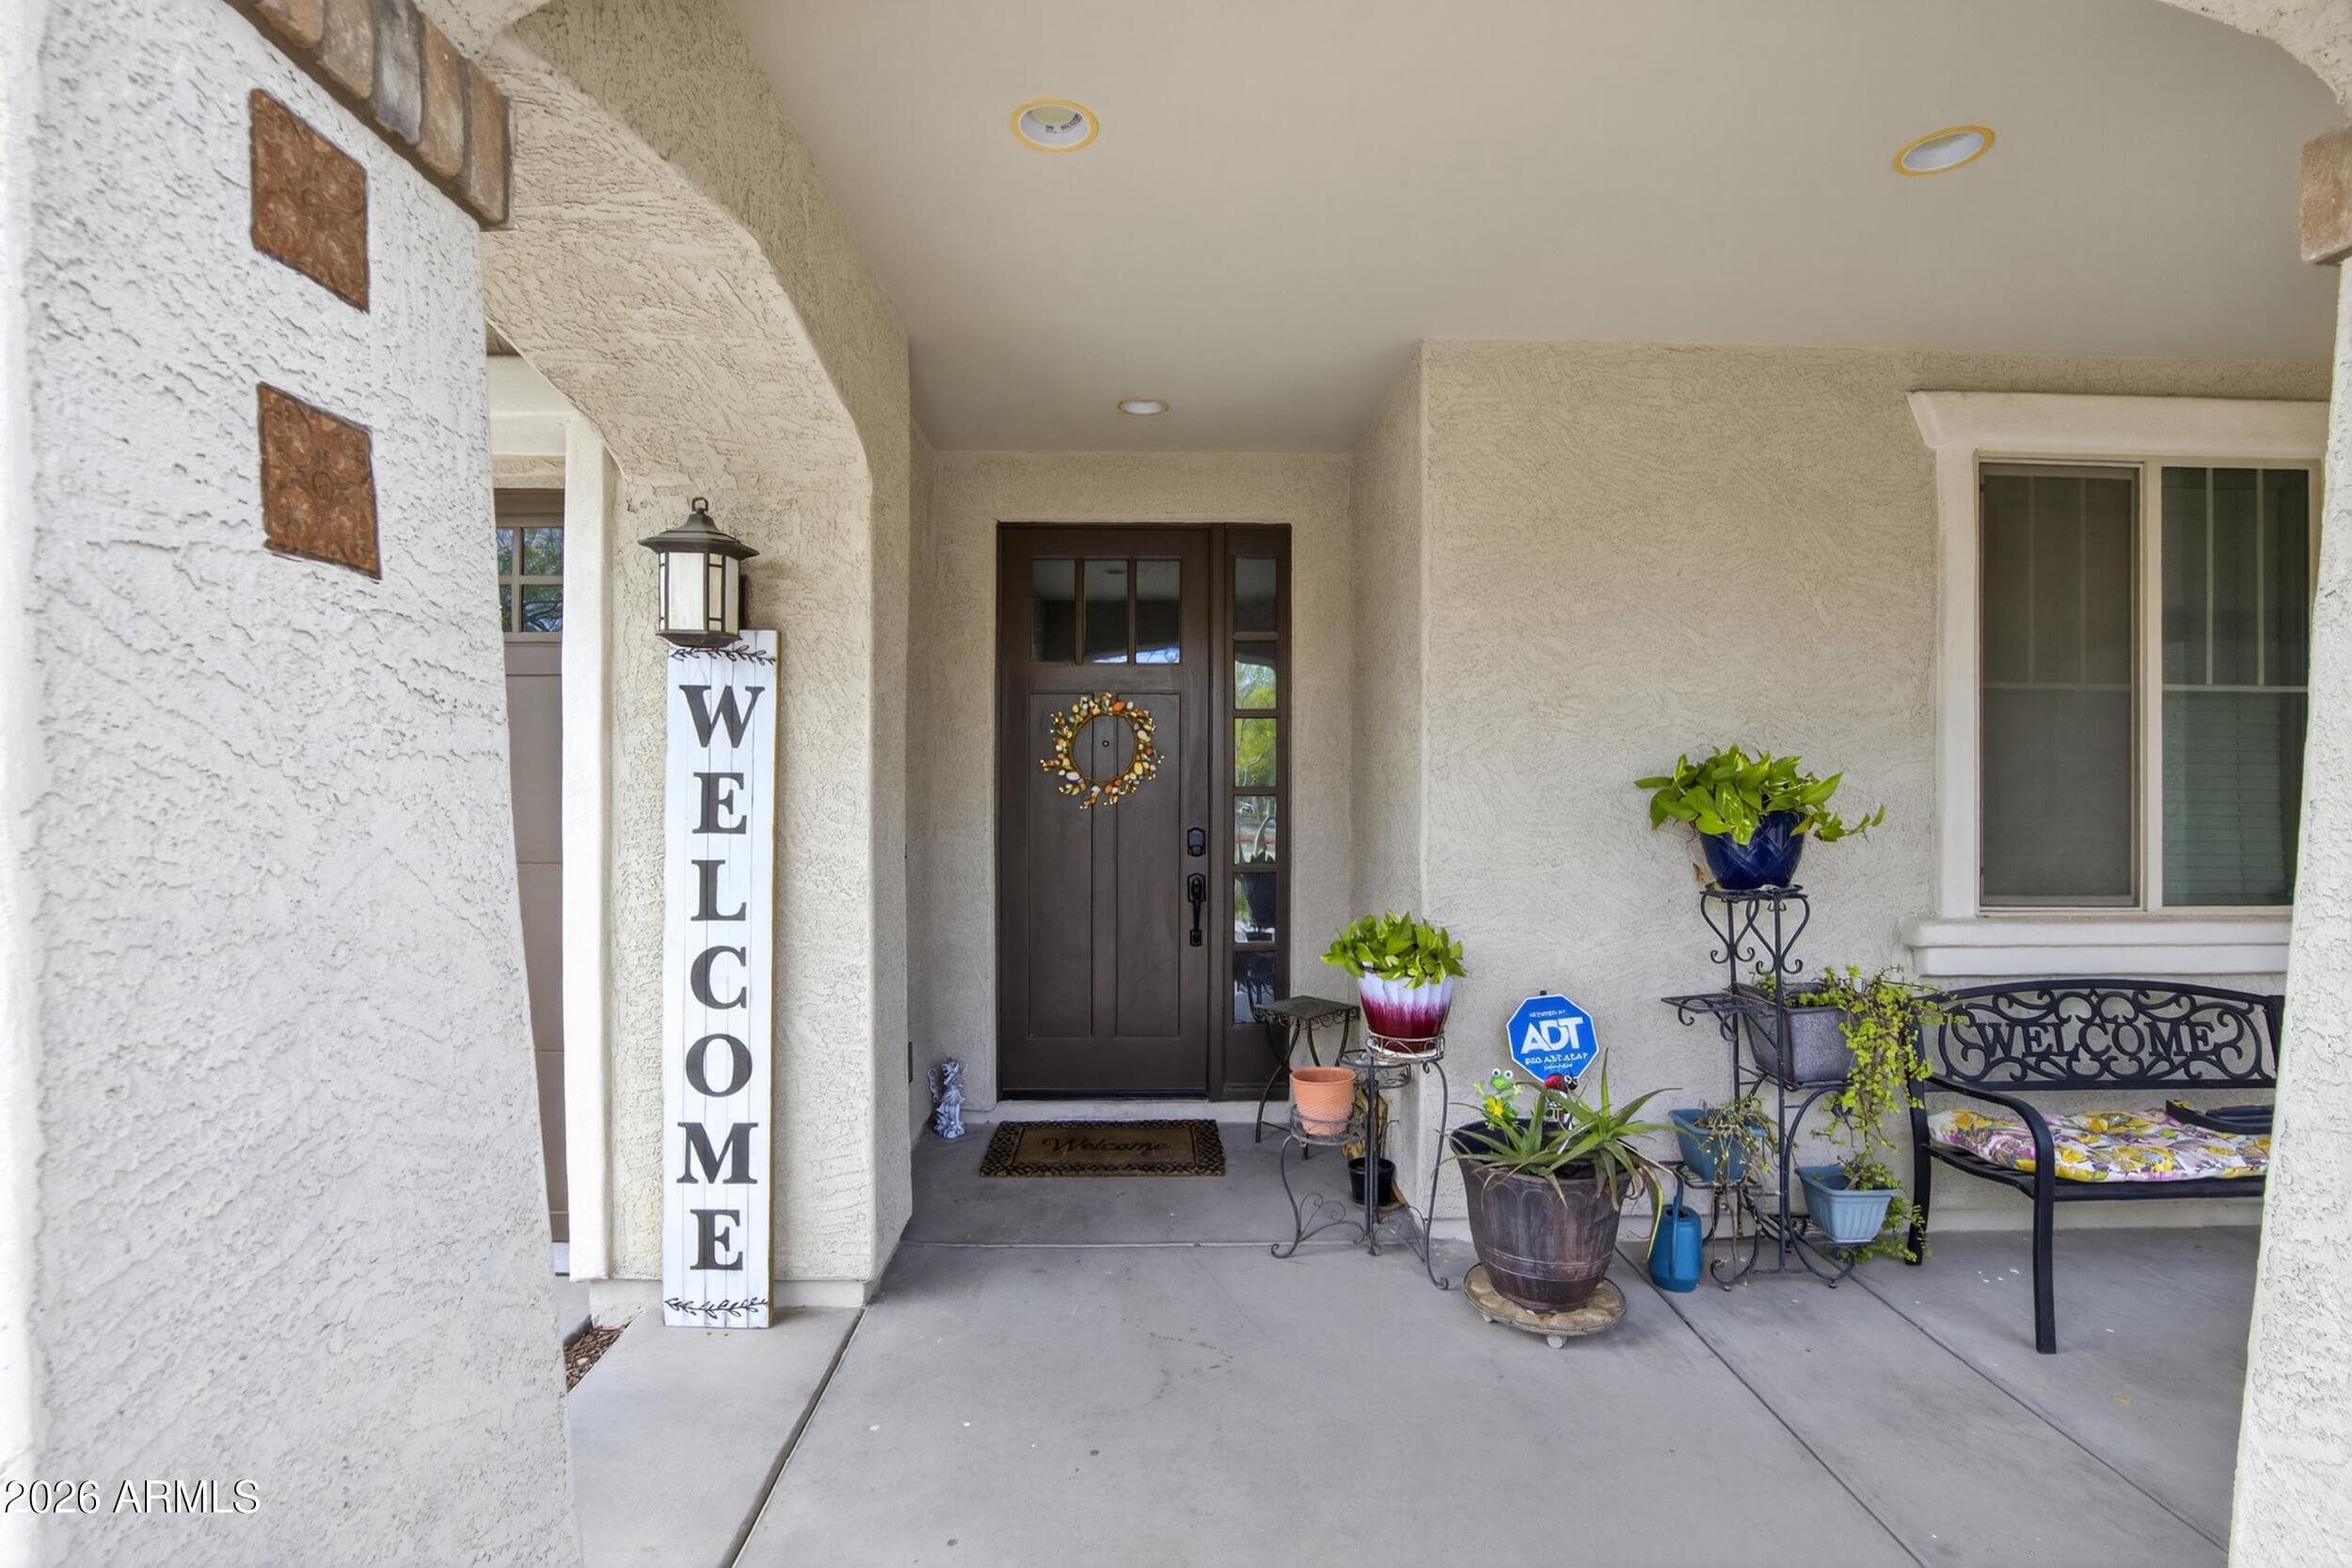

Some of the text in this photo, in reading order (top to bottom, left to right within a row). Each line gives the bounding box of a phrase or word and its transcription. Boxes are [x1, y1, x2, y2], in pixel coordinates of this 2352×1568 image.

[676, 685, 765, 1271] WELCOME
[1520, 1017, 1583, 1053] ADT
[1977, 1021, 2217, 1058] WELCOME
[1041, 1137, 1174, 1155] Welcome
